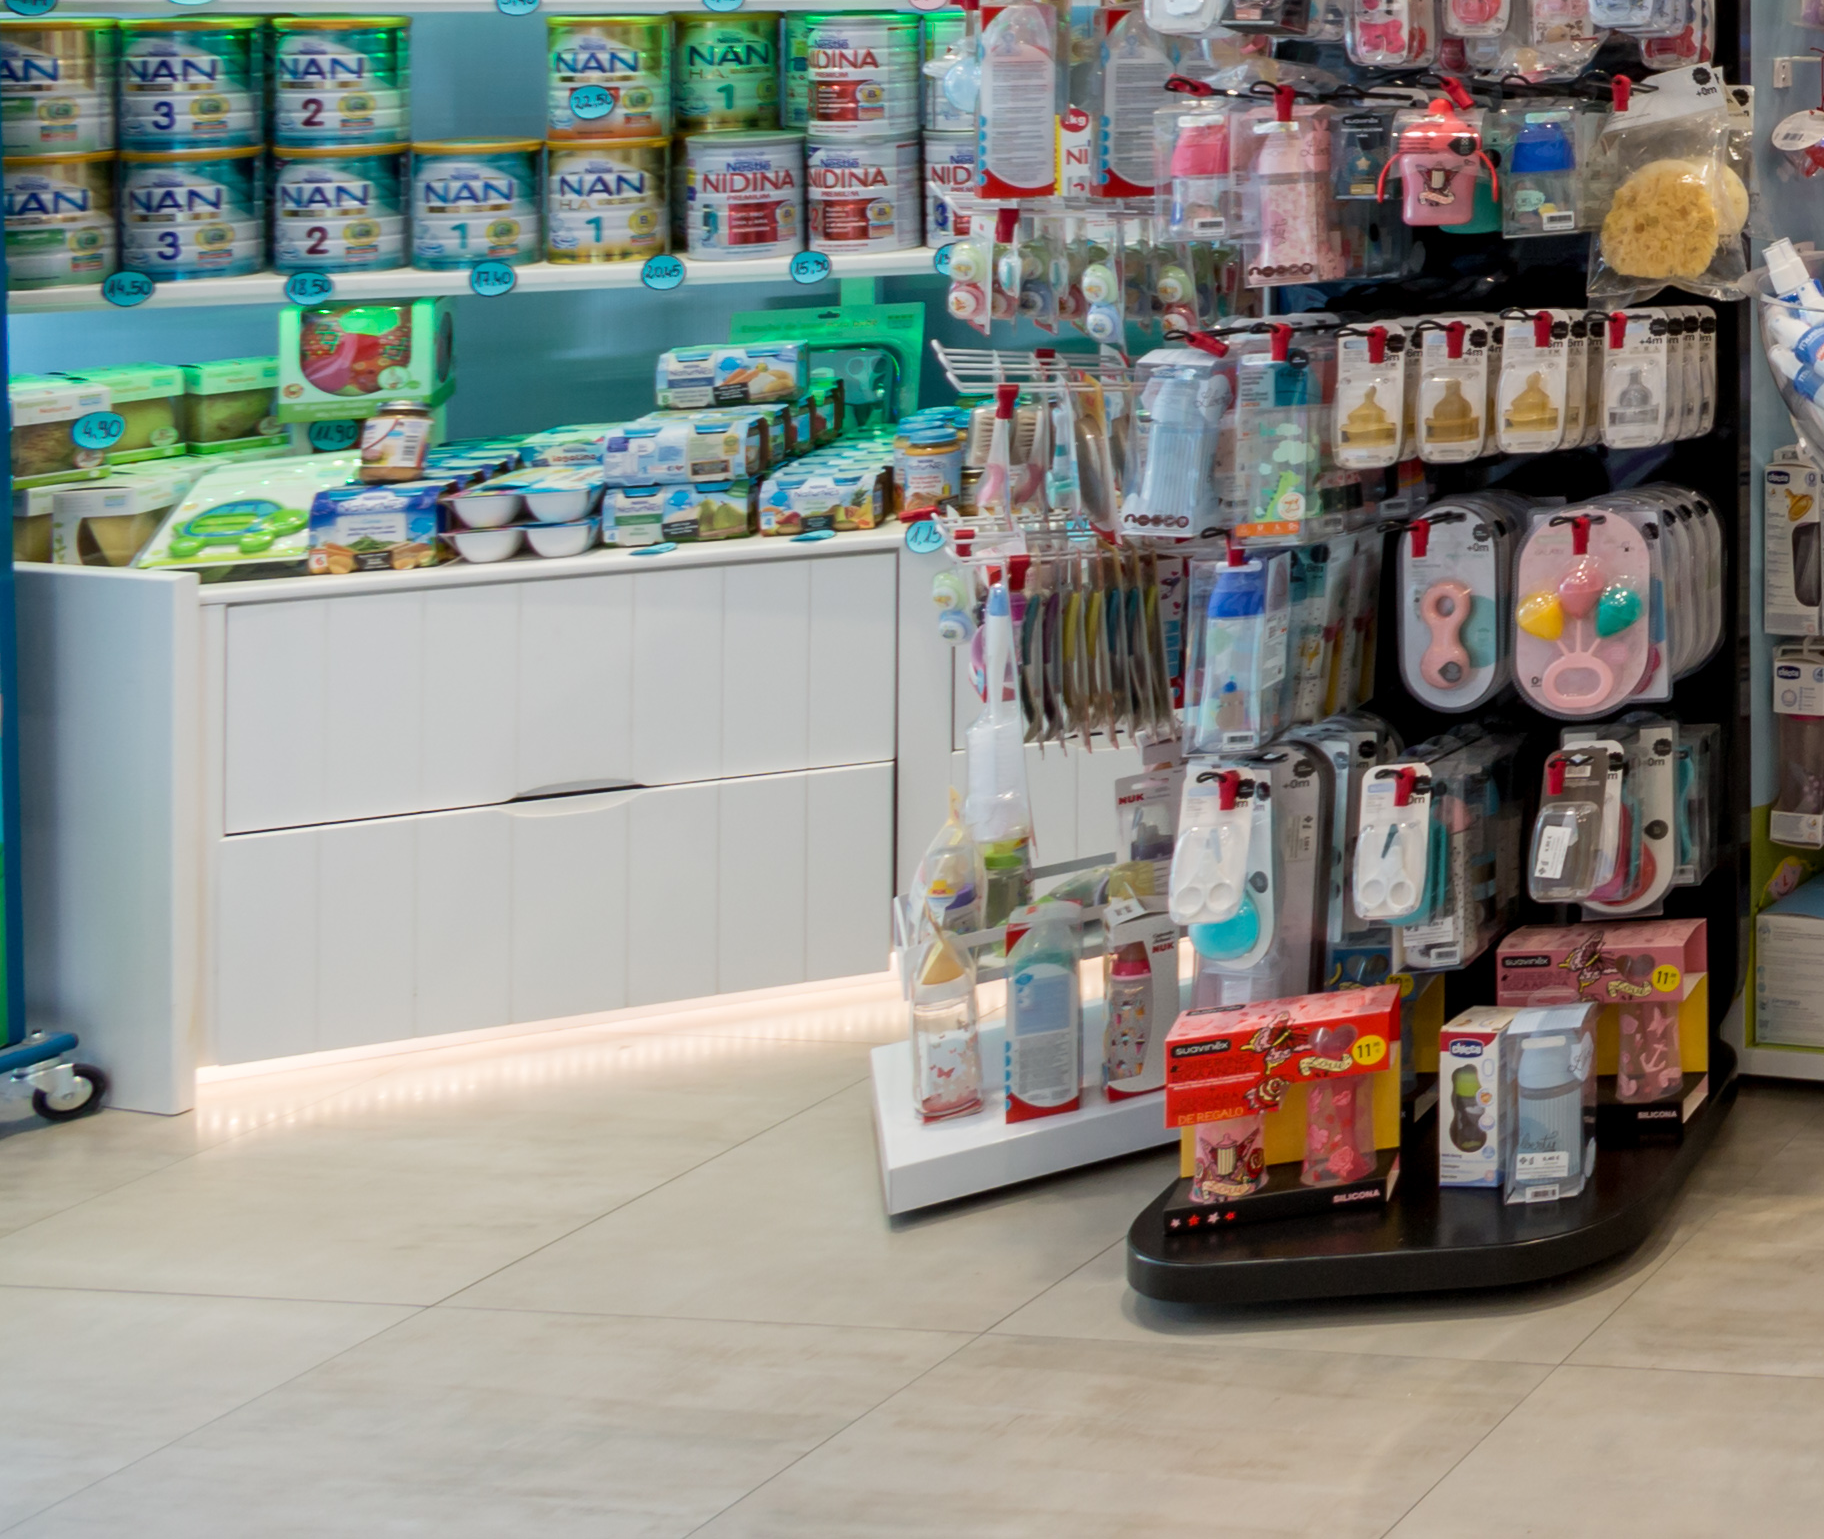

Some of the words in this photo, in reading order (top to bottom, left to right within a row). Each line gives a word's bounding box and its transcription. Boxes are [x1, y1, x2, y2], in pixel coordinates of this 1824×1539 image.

[555, 53, 638, 74] NAN
[688, 46, 770, 67] NAN
[152, 101, 175, 130] 3
[302, 98, 325, 127] 2
[560, 175, 644, 196] NAN
[703, 170, 794, 193] NIDINA
[129, 187, 223, 213] NAN
[280, 183, 370, 208] NAN
[157, 232, 181, 260] 3
